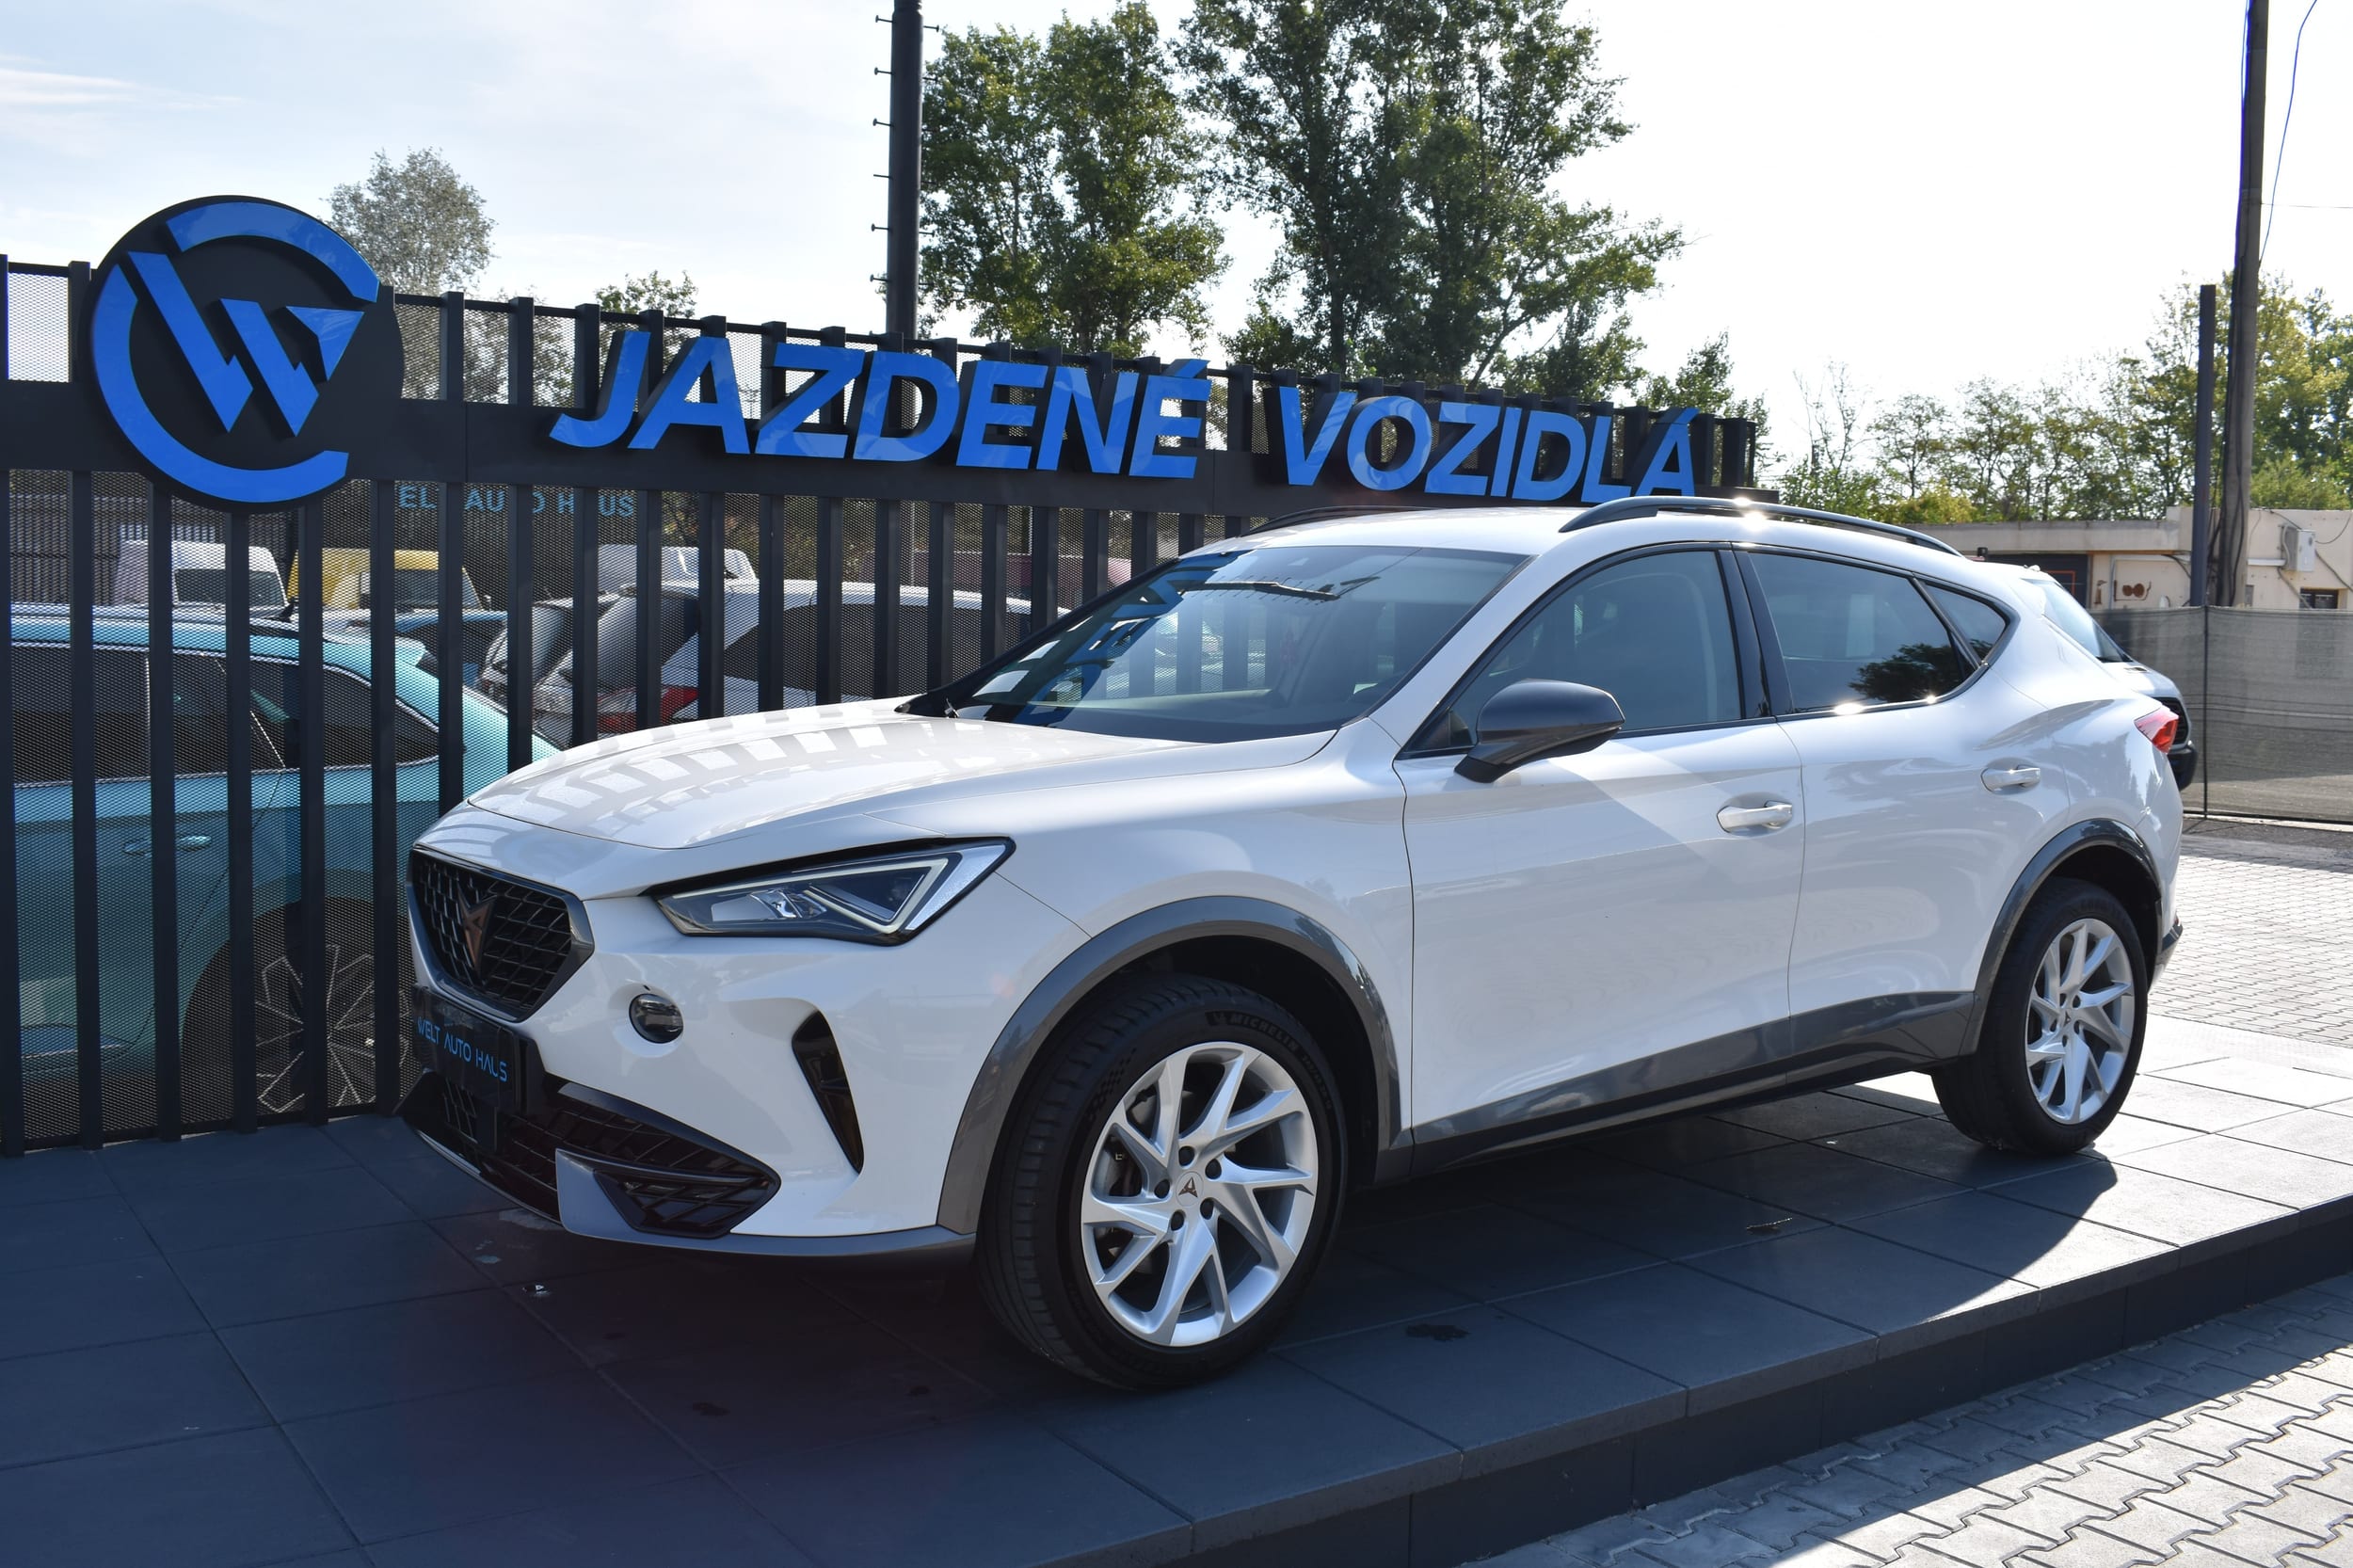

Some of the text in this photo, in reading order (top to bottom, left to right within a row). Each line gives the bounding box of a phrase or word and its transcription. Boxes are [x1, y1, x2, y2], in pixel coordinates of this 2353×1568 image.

[549, 330, 1700, 504] JAZDENÉ VOZIDLÁ
[465, 488, 546, 514] AUO
[558, 493, 634, 518] HUS
[417, 1016, 440, 1045] WELT
[444, 1032, 472, 1063] AUTO
[1229, 1013, 1300, 1053] MICHELIN
